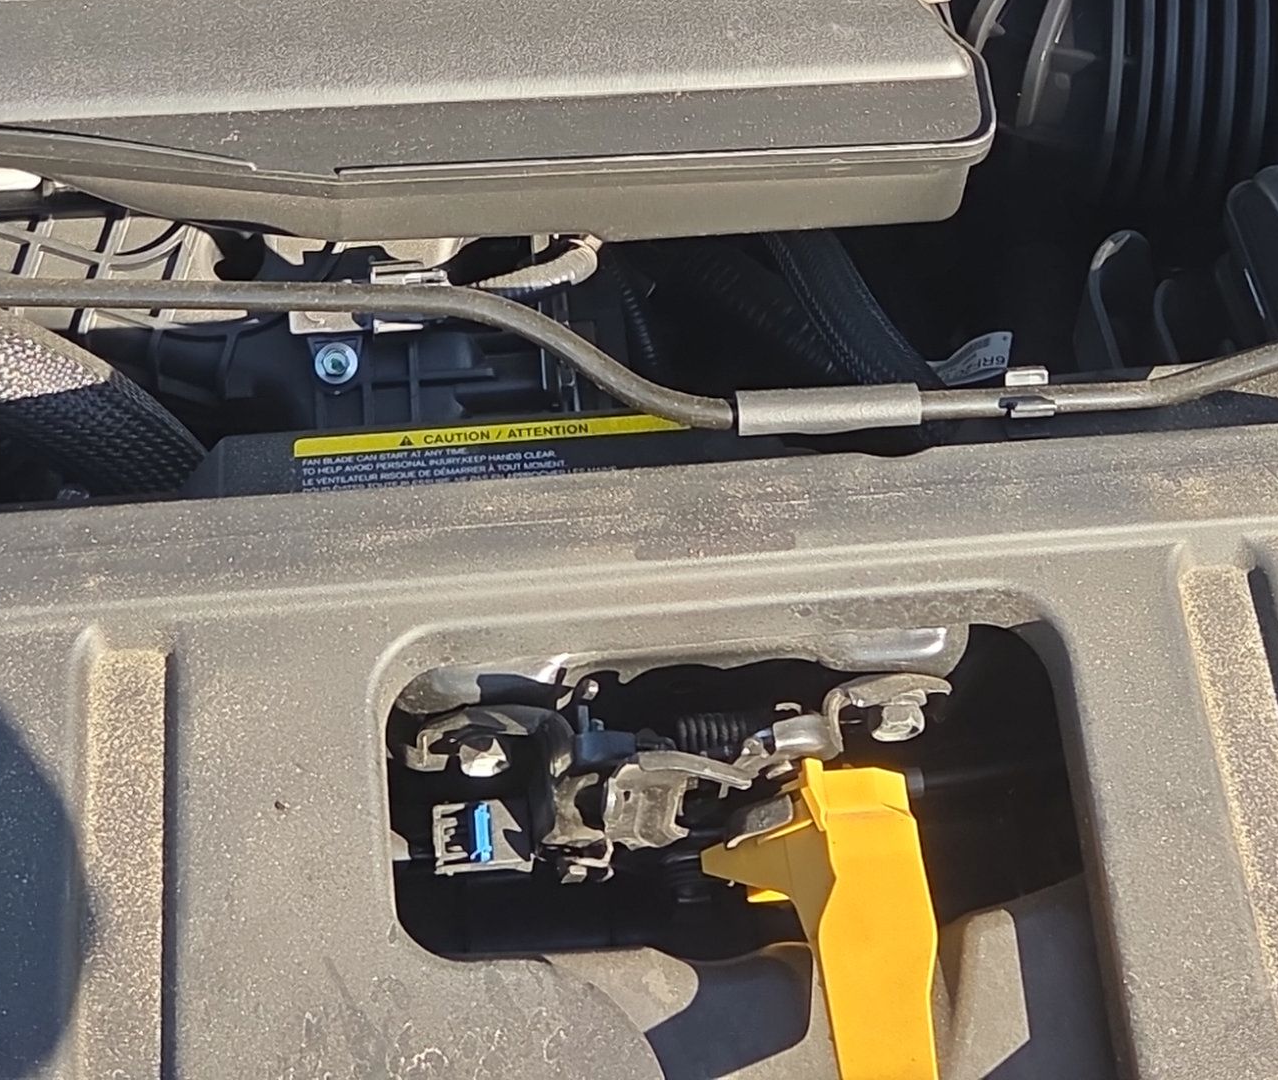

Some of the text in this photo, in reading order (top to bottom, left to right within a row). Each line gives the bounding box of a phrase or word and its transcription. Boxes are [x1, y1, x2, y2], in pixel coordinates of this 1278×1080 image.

[423, 430, 491, 445] CAUTION
[507, 423, 590, 439] ATTENTION
[302, 458, 321, 467] FAN
[322, 455, 353, 465] BLADE
[356, 453, 378, 463] CAN
[379, 451, 408, 461] START
[424, 449, 444, 458] ANY
[302, 467, 315, 476] TO
[317, 465, 342, 475] HELP
[344, 463, 374, 473] AVOID
[376, 459, 427, 470] PERSONAL
[488, 452, 522, 462] HANDS
[302, 478, 314, 486] LE
[315, 474, 379, 485] VENTILATEUR
[380, 471, 416, 481] RISQUE
[418, 469, 431, 478] DE
[433, 464, 486, 476] DÉMARRER
[488, 462, 496, 473] À
[497, 462, 522, 472] TOUT
